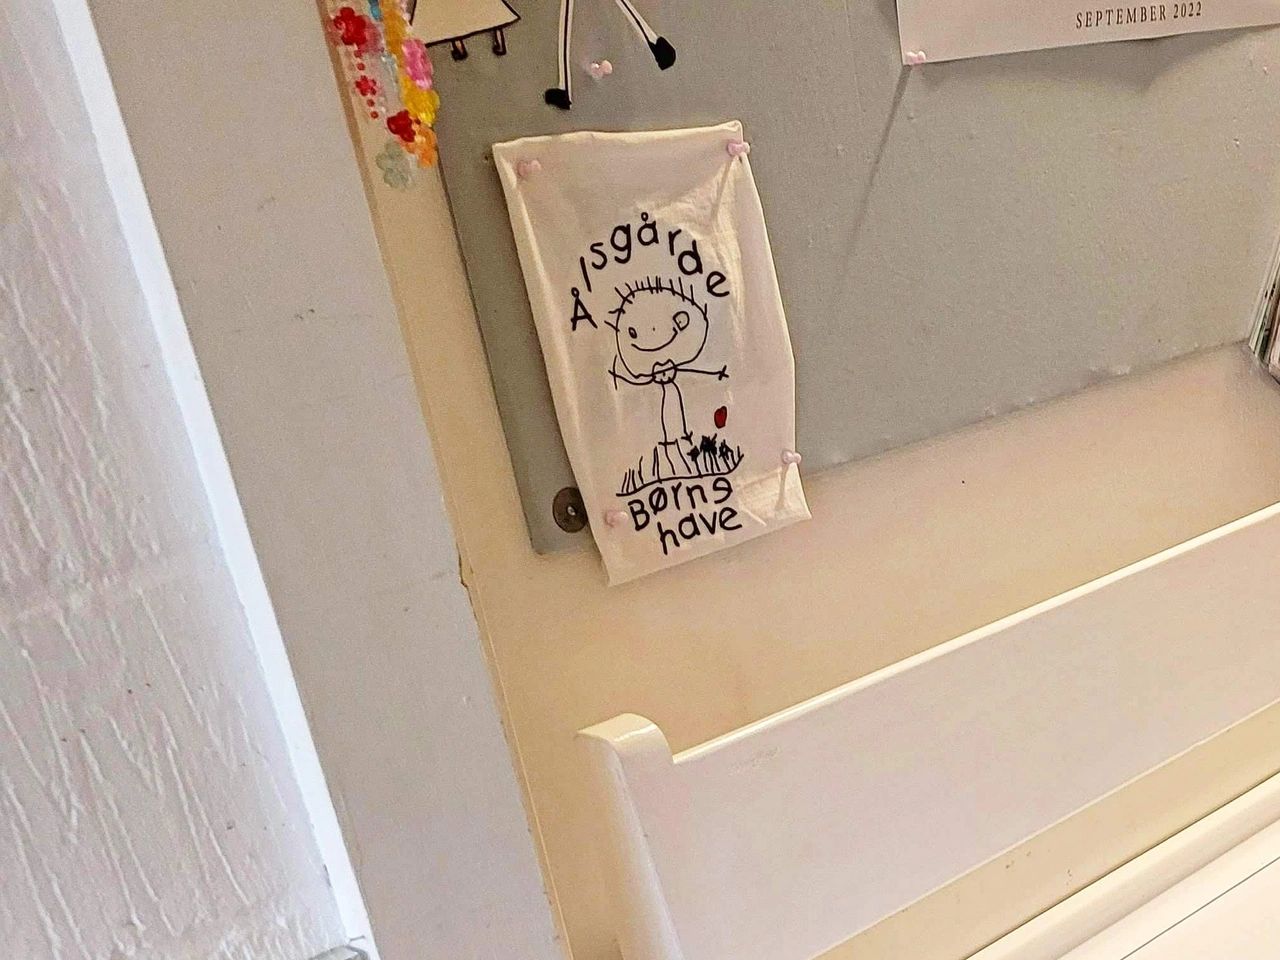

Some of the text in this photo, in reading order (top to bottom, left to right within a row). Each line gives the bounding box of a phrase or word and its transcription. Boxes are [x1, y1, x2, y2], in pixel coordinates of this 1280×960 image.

[1075, 1, 1202, 29] SEPTEMBER 2022
[570, 211, 730, 332] Ålsgårde
[657, 506, 743, 556] have
